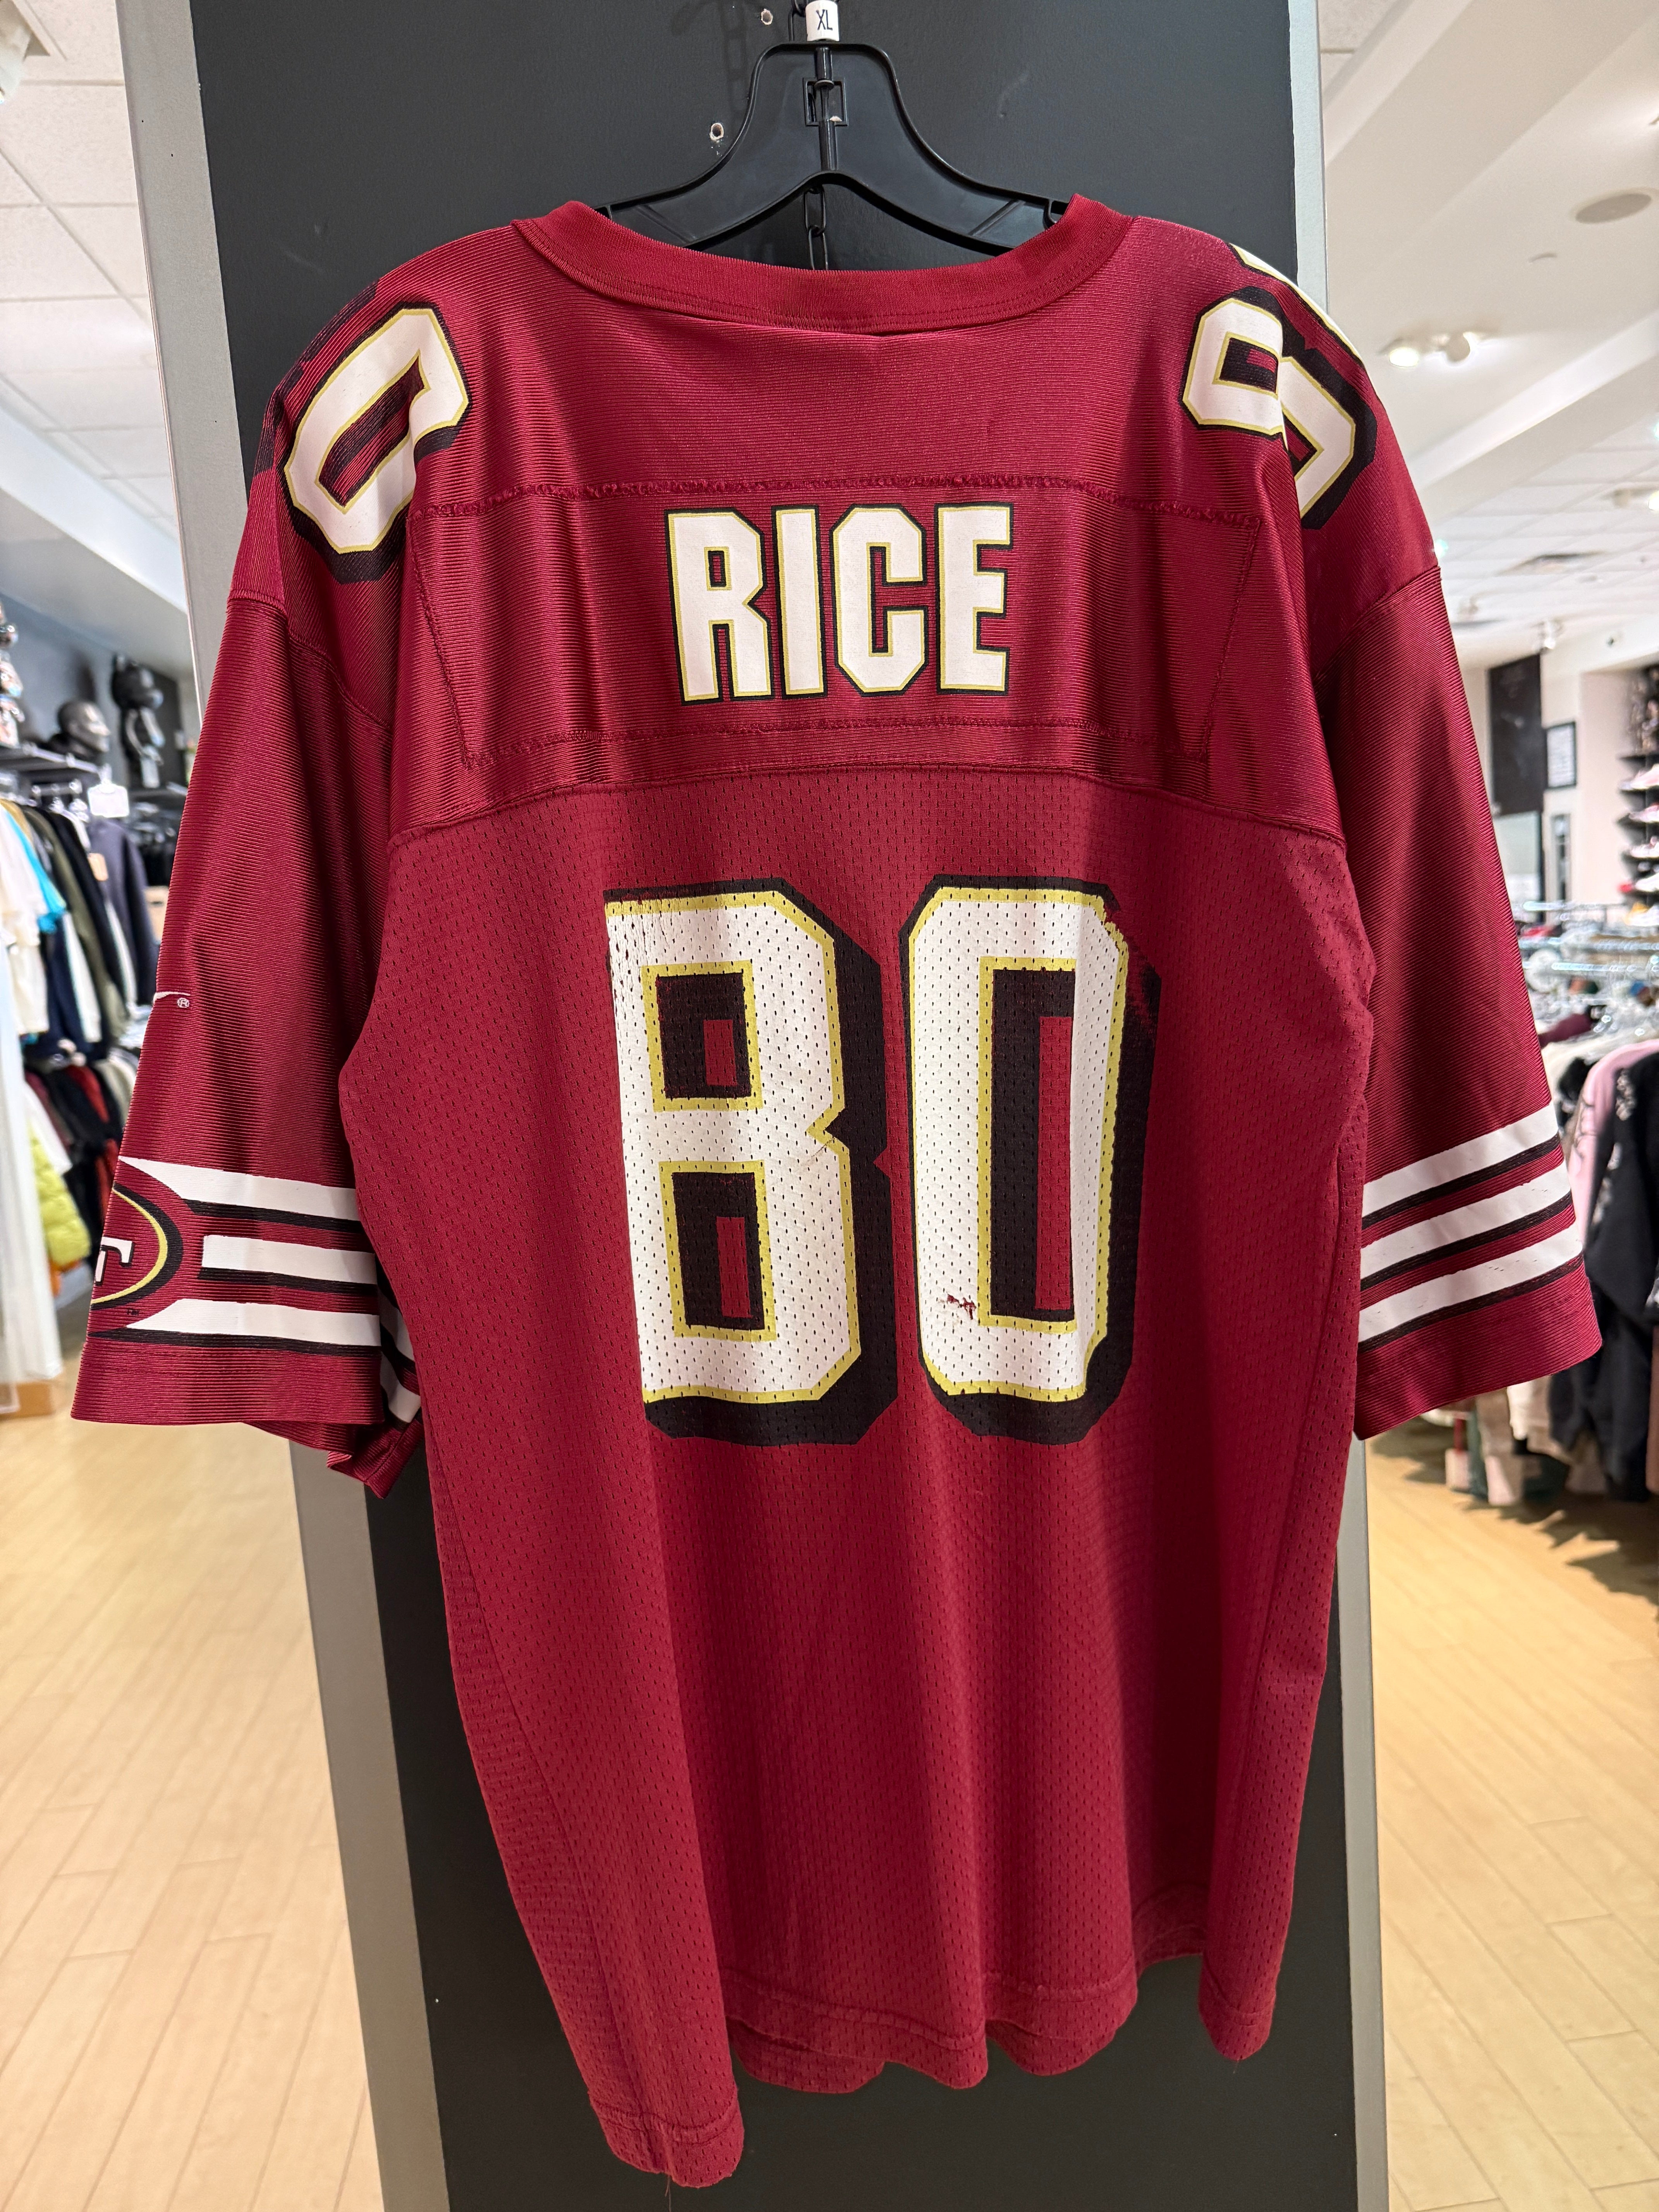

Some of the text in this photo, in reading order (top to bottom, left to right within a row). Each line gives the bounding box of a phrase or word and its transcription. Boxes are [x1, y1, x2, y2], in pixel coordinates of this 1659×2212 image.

[816, 9, 833, 31] XL
[665, 502, 1013, 705] RICE
[603, 876, 1161, 1445] 80
